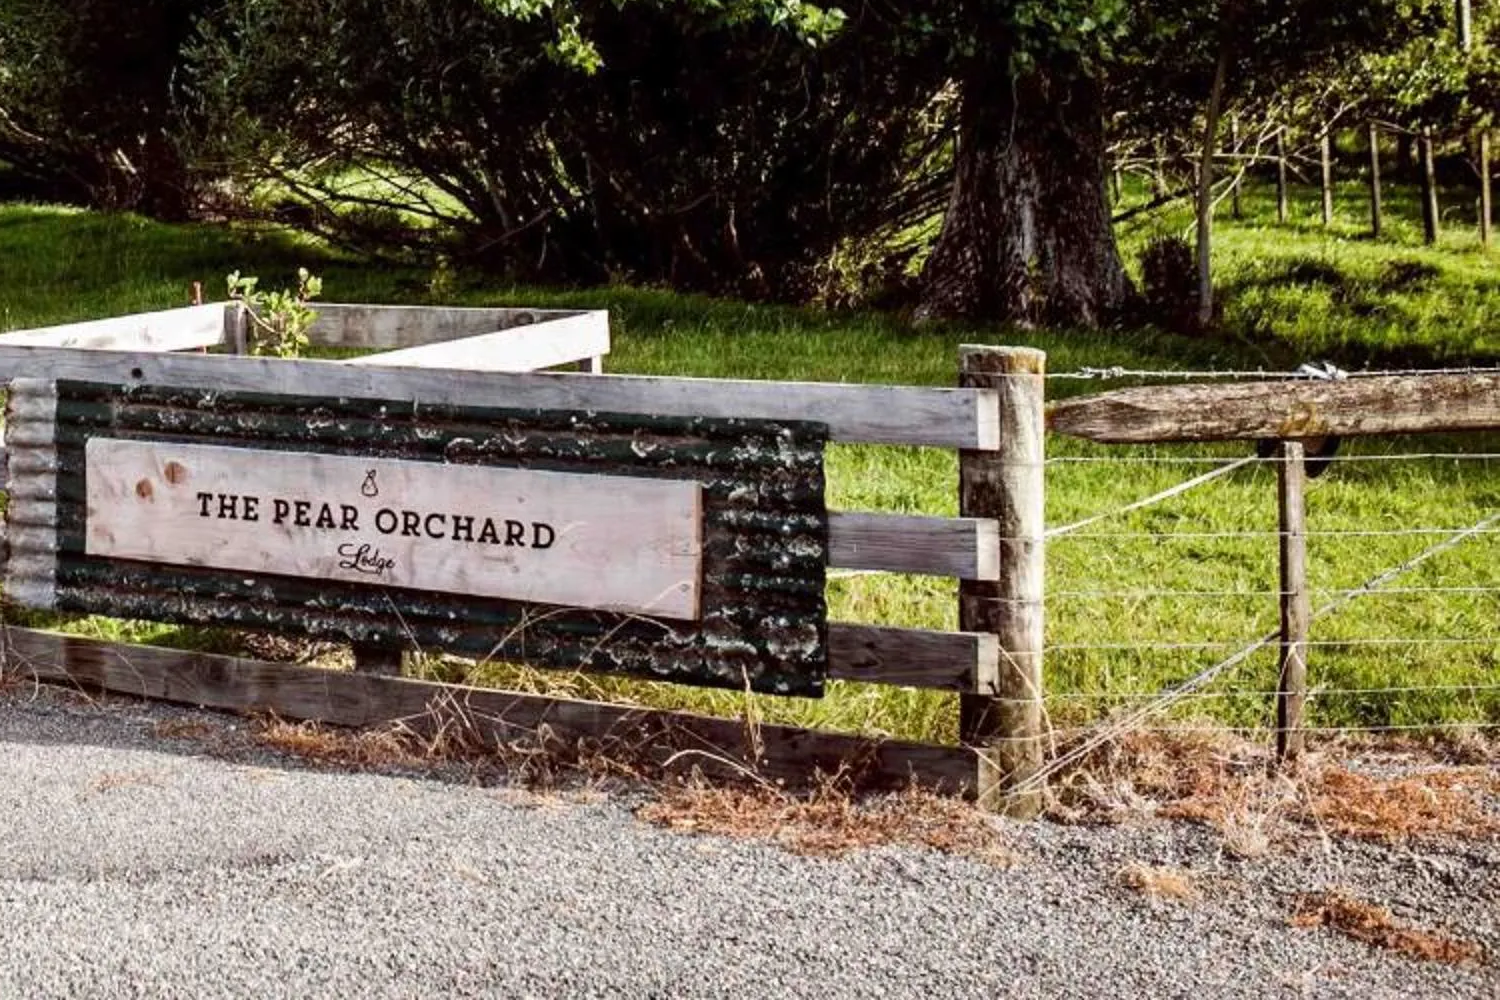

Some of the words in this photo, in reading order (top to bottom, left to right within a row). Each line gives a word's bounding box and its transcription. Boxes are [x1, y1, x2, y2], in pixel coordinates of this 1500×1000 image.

[197, 491, 259, 521] THE
[272, 499, 360, 531] PEAR
[375, 507, 556, 550] ORCHARD
[337, 543, 395, 575] Lodge
